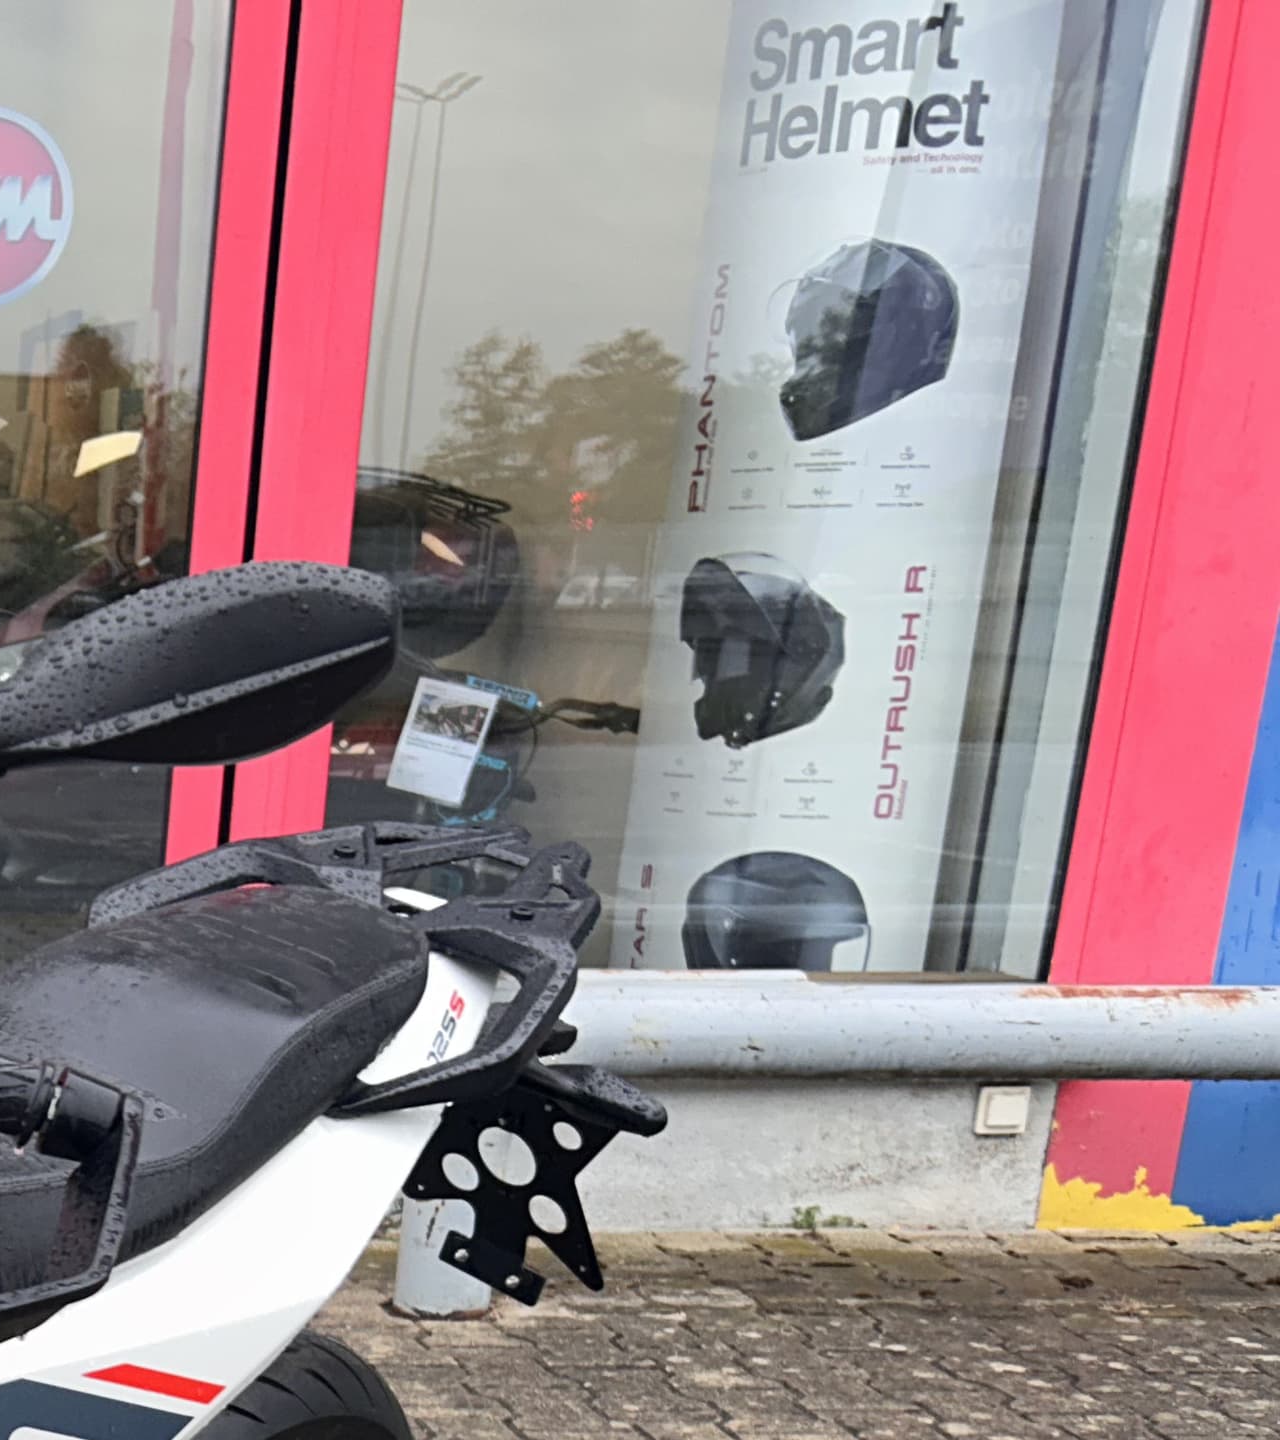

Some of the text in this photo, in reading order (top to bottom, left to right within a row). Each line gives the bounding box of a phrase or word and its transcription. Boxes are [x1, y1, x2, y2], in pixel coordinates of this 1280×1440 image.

[749, 1, 964, 92] Smart
[740, 80, 990, 167] Helmet
[687, 264, 730, 512] PHANTOM
[874, 565, 927, 819] OUTRUSH R
[426, 988, 466, 1065] 125S
